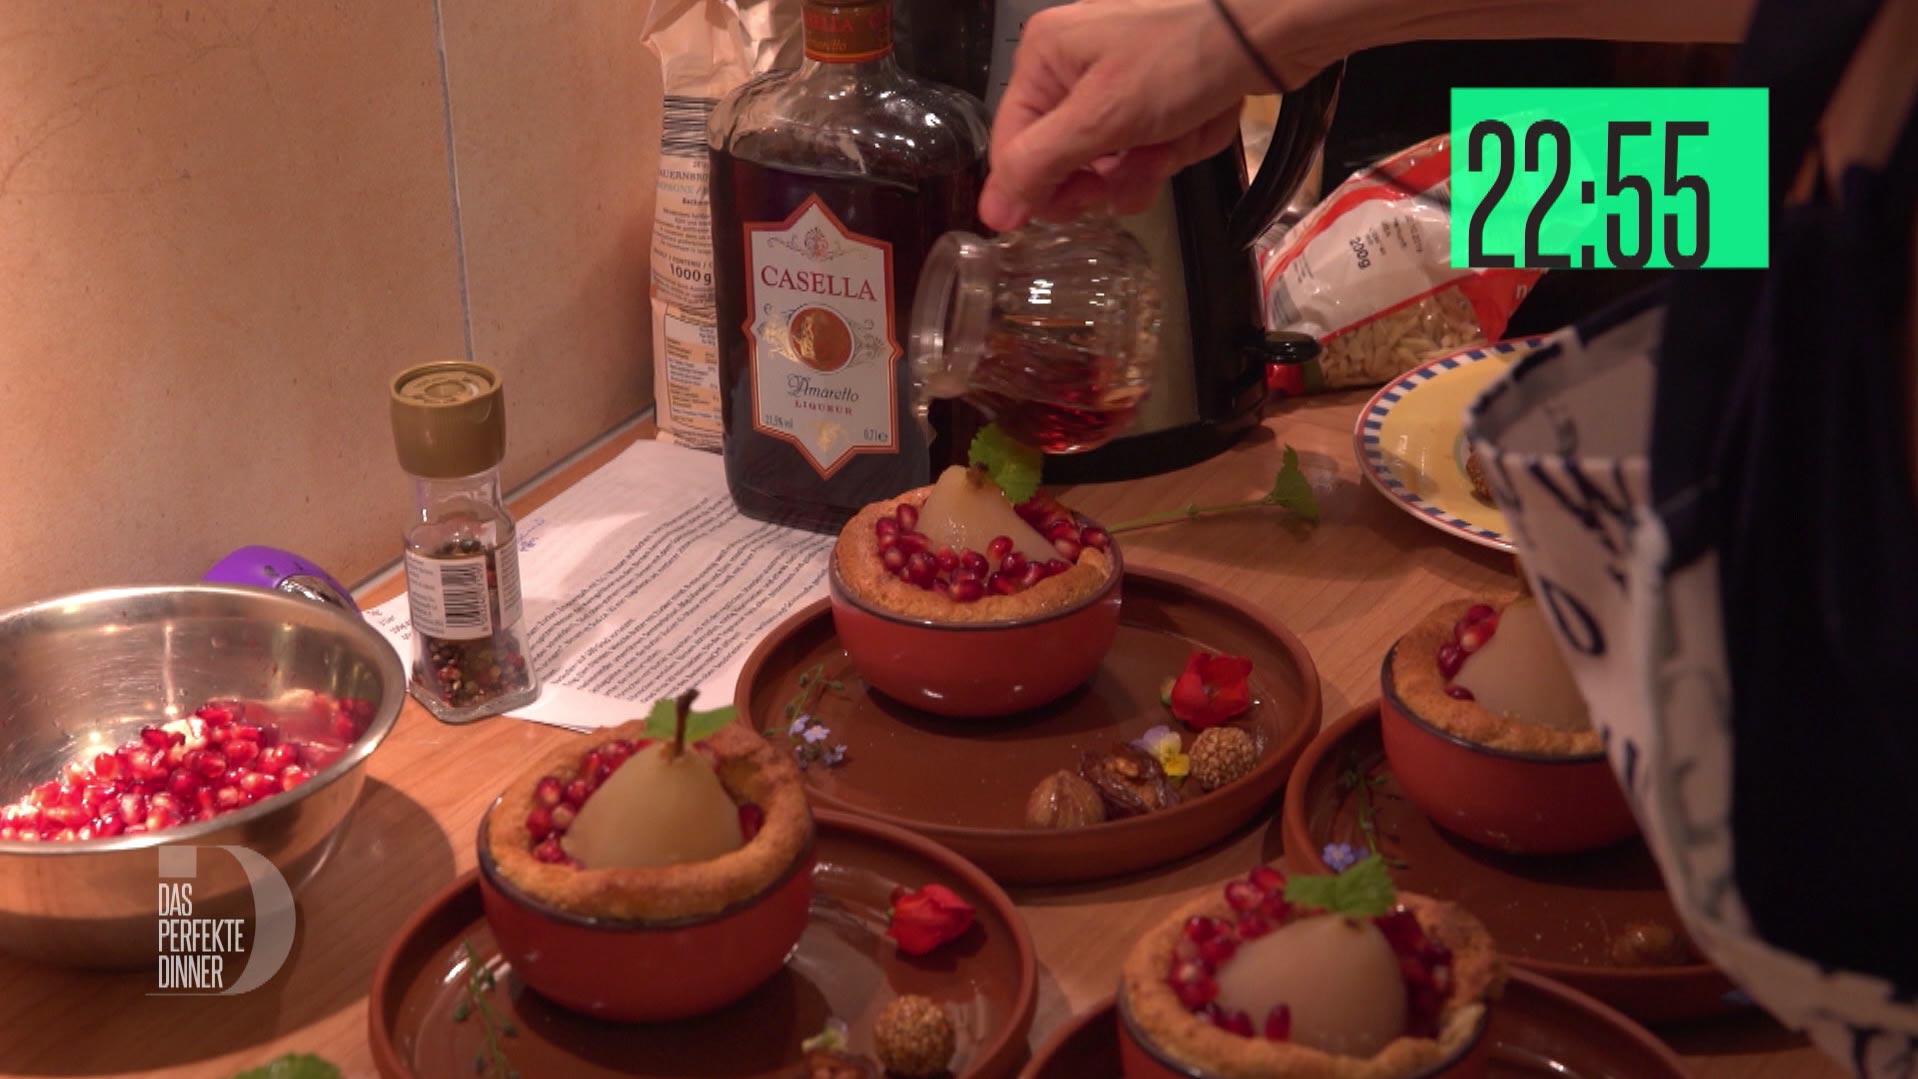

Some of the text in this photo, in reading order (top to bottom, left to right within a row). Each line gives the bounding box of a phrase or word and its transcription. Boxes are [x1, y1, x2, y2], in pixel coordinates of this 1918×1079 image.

[1349, 235, 1371, 270] 200g
[670, 264, 712, 286] 1000 g
[761, 265, 877, 302] CASELLA
[787, 374, 860, 402] Amaretto
[795, 400, 852, 415] LIQUEUR
